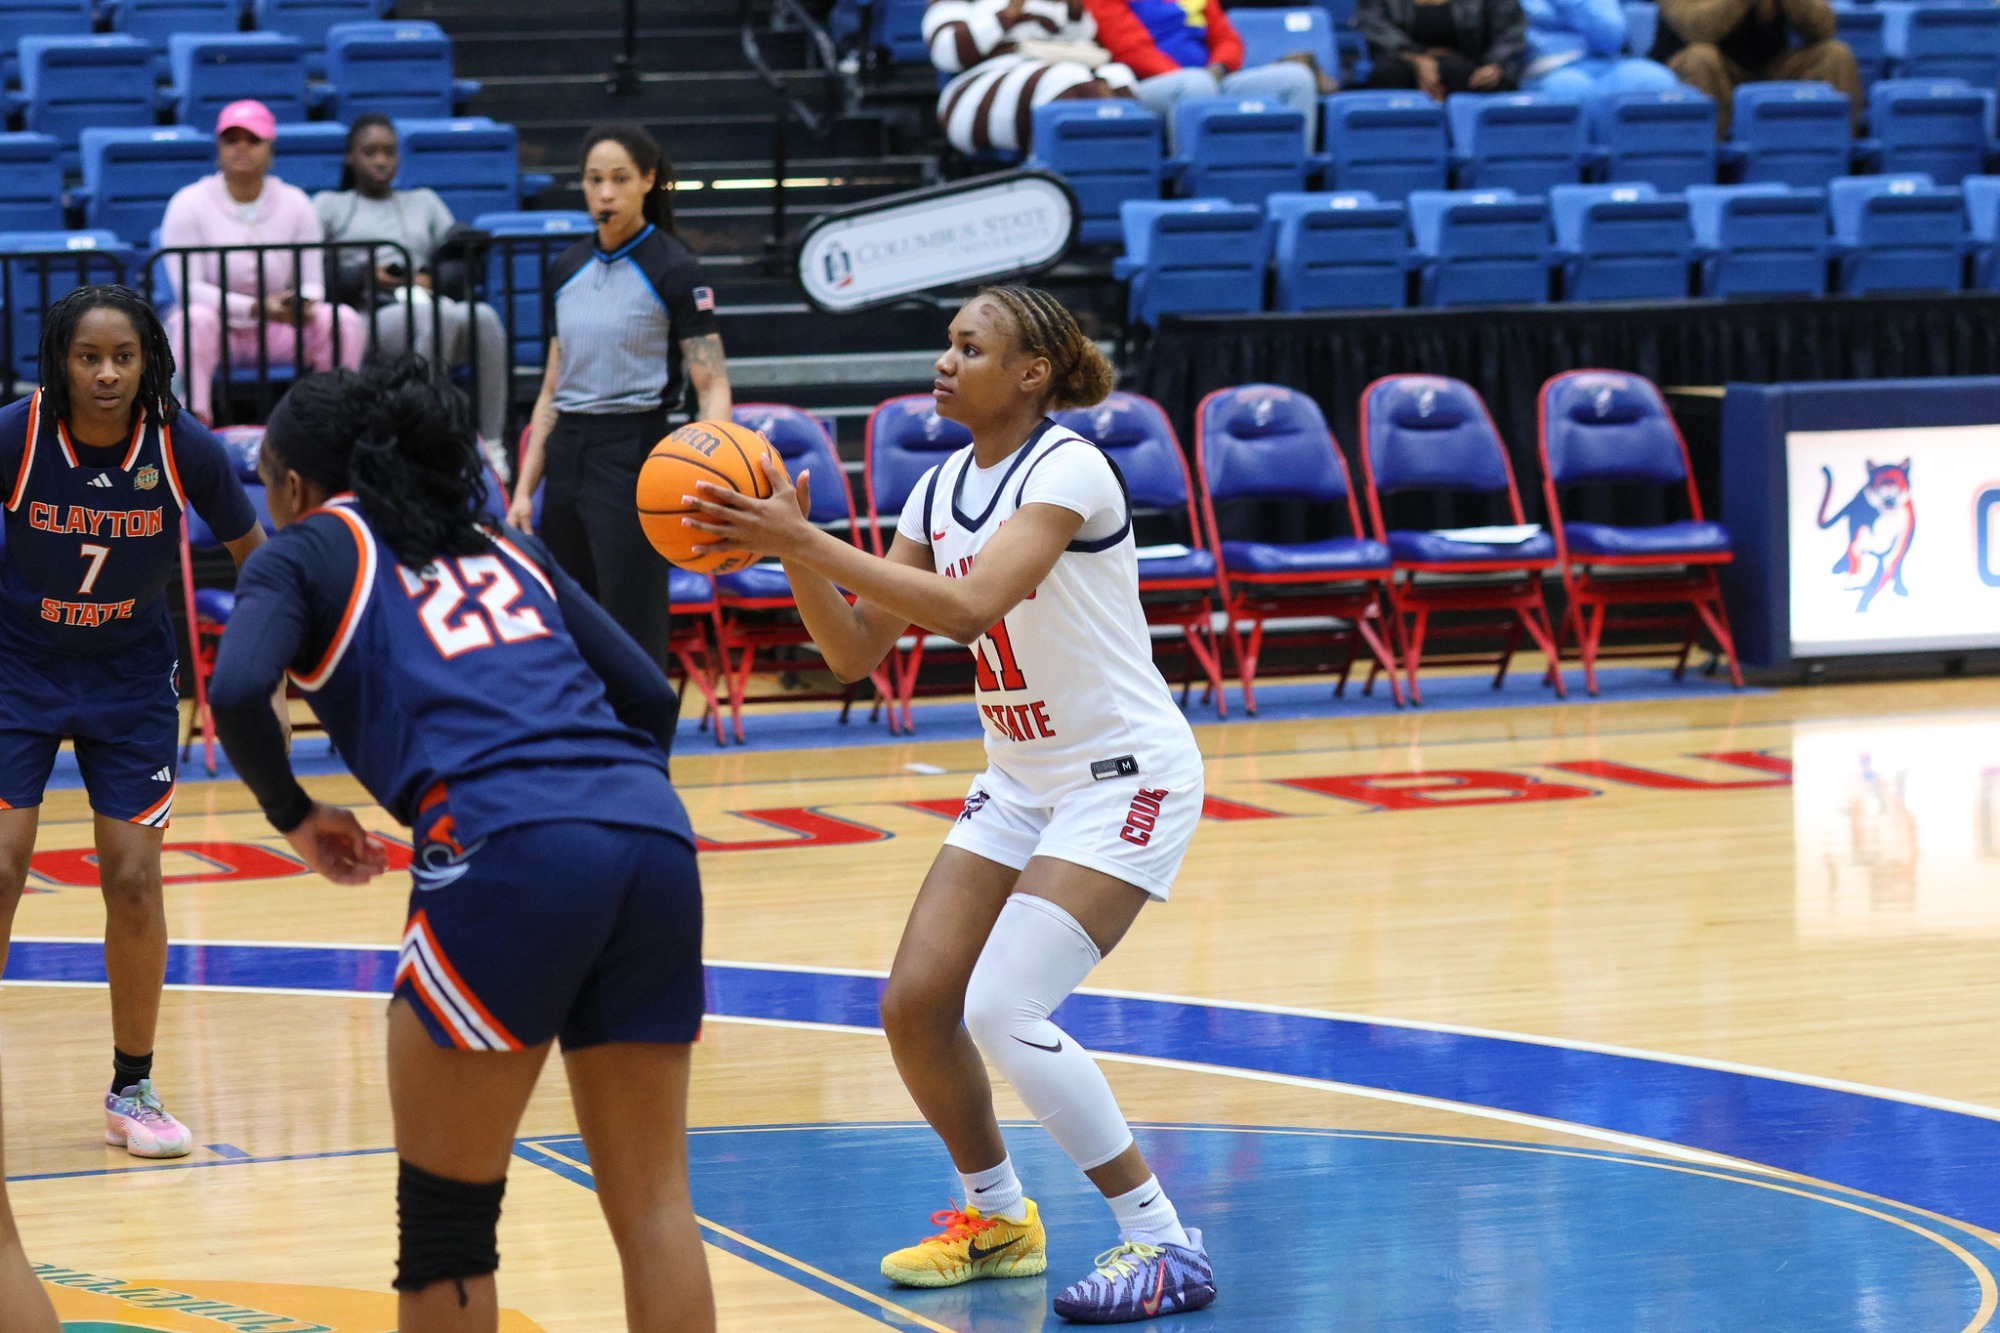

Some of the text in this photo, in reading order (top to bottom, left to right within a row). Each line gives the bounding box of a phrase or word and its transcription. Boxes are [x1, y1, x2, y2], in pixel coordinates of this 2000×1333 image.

[29, 501, 163, 538] CLAYTON
[77, 543, 111, 594] 7
[41, 597, 135, 628] STATE
[395, 554, 552, 660] 22
[981, 700, 1056, 742] STATE
[1121, 760, 1132, 772] M
